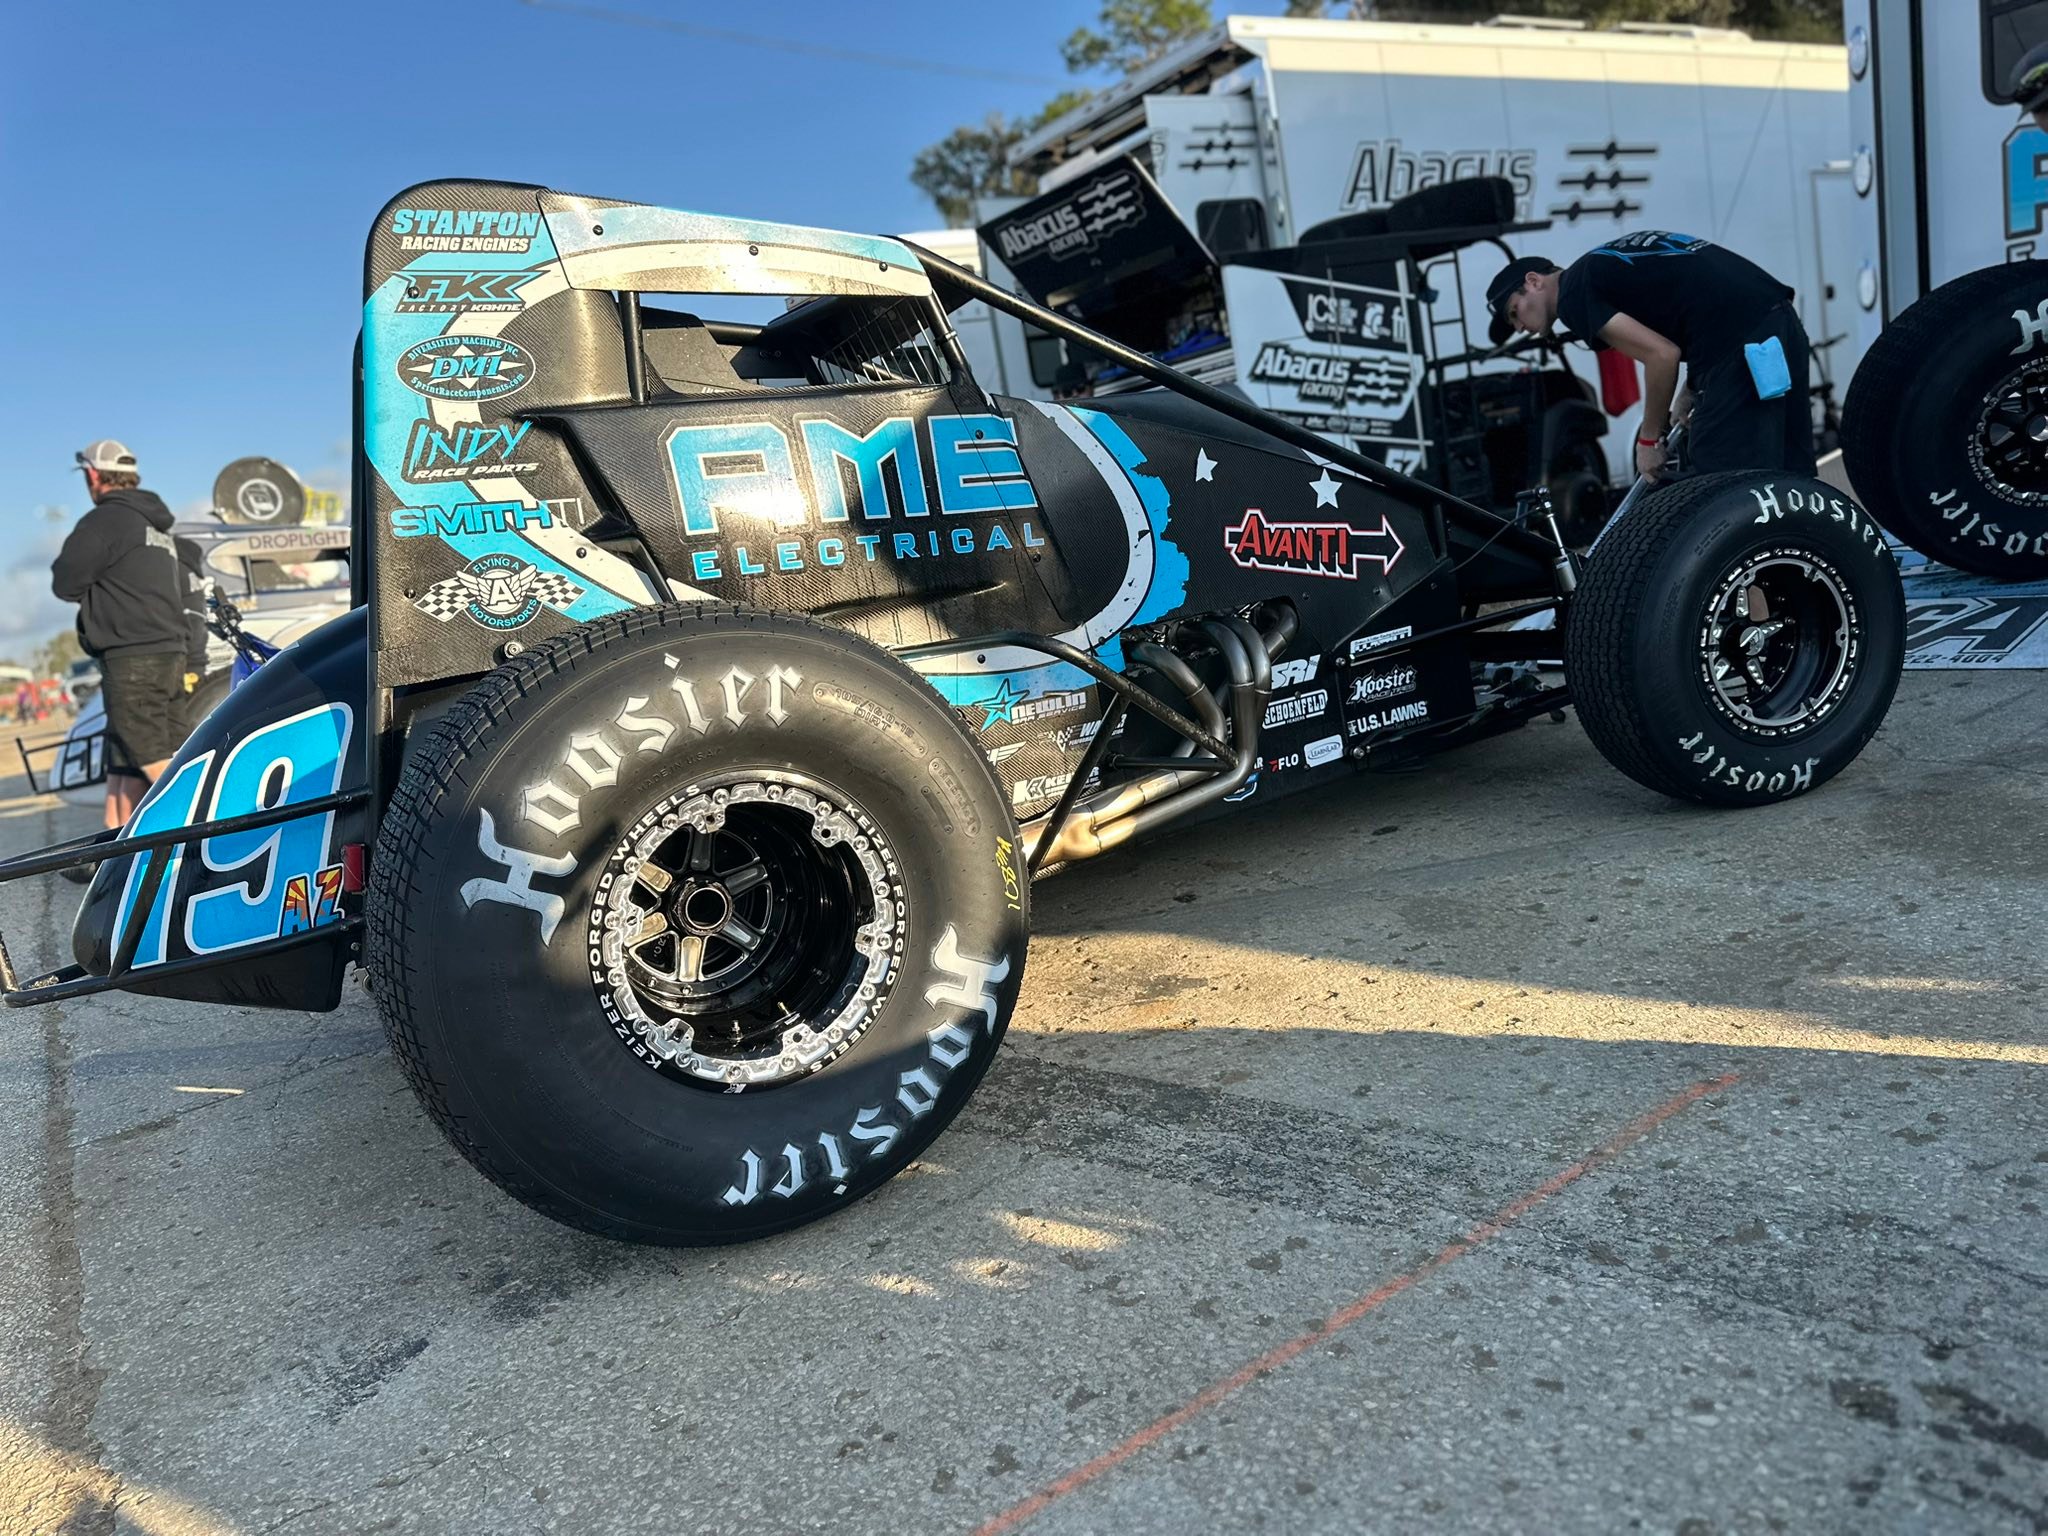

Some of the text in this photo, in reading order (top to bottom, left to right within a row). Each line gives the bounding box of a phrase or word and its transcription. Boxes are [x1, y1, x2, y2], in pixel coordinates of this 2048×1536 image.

[392, 208, 541, 237] STANTON
[1001, 204, 1081, 257] Abacus
[401, 237, 529, 252] RACING ENGINES
[397, 304, 466, 312] FACTORY
[408, 337, 460, 360] DIVERSIFIED
[462, 336, 502, 349] MACHINE
[1252, 346, 1350, 383] Abacus
[431, 355, 502, 378] DMI
[410, 373, 526, 399] SprintRaceComponents.com
[408, 420, 534, 476] INDY
[414, 463, 539, 479] RACE PARTS
[667, 414, 1039, 536] AME
[391, 501, 551, 537] SMITH
[1750, 484, 1887, 556] Hoosier
[249, 530, 348, 549] DROPLIGHT
[691, 523, 1046, 580] ELECTRICAL
[1236, 515, 1347, 565] AVANTI
[473, 557, 520, 574] FLYING A
[469, 599, 538, 627] MOTORSPORTS
[1271, 654, 1321, 690] SRI
[1351, 669, 1414, 701] Hoosier
[854, 707, 892, 731] DIRT
[1264, 694, 1326, 725] SCHOENFELD
[1357, 700, 1428, 733] U.S. LAWNS
[1278, 753, 1299, 770] FLO
[1679, 731, 1819, 796] Hoosier
[459, 653, 804, 947] Hoosier
[110, 701, 354, 970] 19
[279, 864, 345, 937] AZ
[589, 784, 701, 1070] KEIZER FORGED WHEELS
[810, 803, 906, 1073] KEIZER FORGED WHEELS
[721, 923, 1011, 1207] Hoosier
